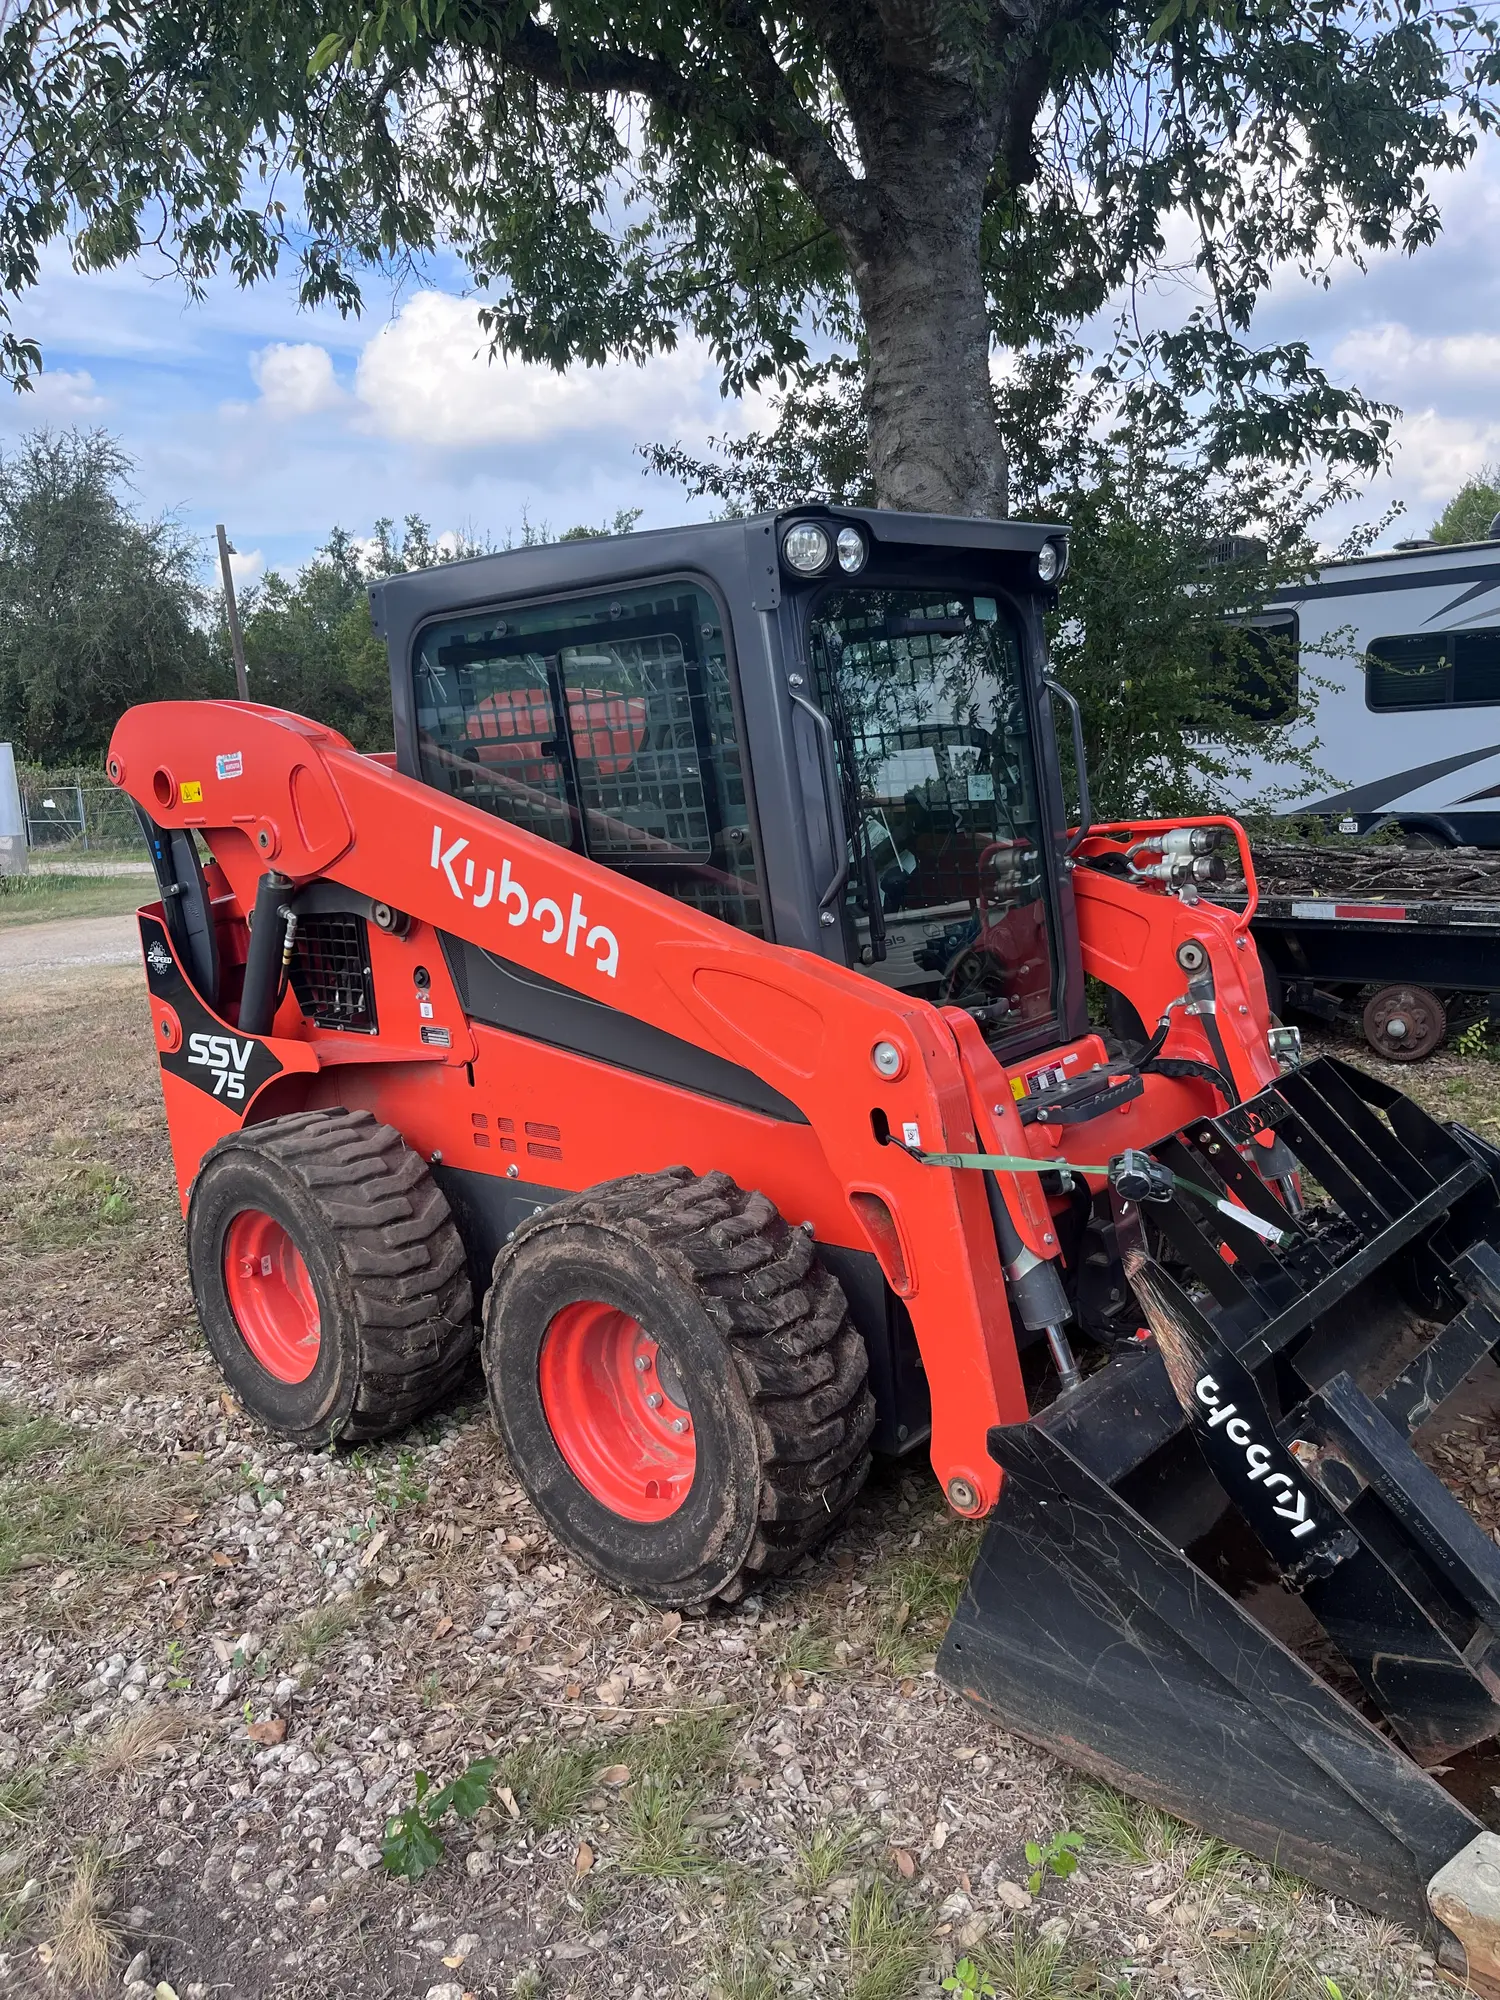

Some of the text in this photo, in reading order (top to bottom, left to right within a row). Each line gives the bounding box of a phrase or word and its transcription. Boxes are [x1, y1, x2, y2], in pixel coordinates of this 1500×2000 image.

[430, 825, 619, 978] Kubota
[188, 1032, 254, 1071] SSV
[211, 1069, 245, 1099] 75
[1195, 1374, 1316, 1538] Kubota
